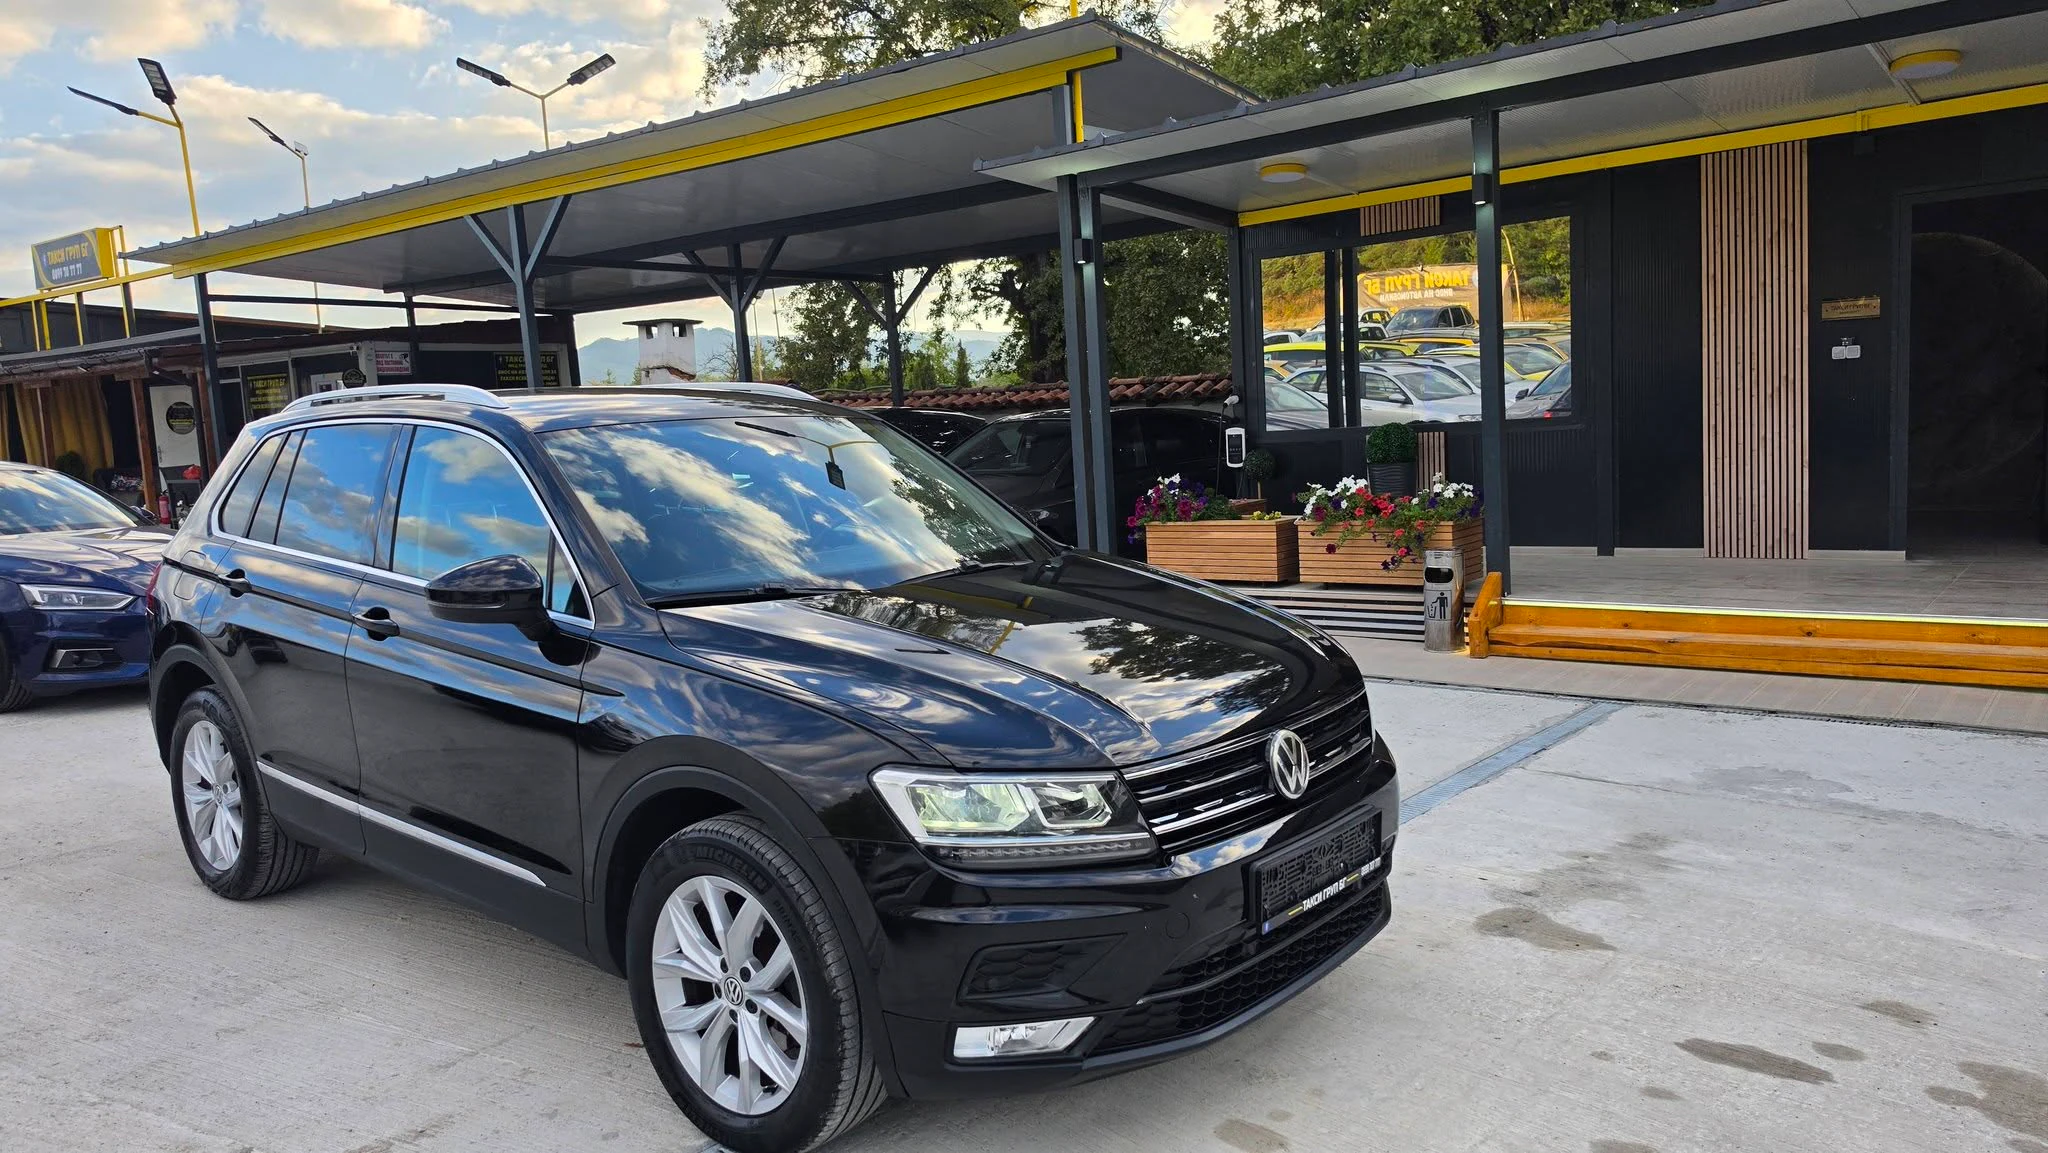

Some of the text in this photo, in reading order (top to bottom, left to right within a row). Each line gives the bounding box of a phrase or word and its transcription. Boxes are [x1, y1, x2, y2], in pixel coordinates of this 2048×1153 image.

[696, 846, 767, 893] MICHELIN
[1323, 881, 1339, 900] ГРУП
[1339, 876, 1347, 891] БГ
